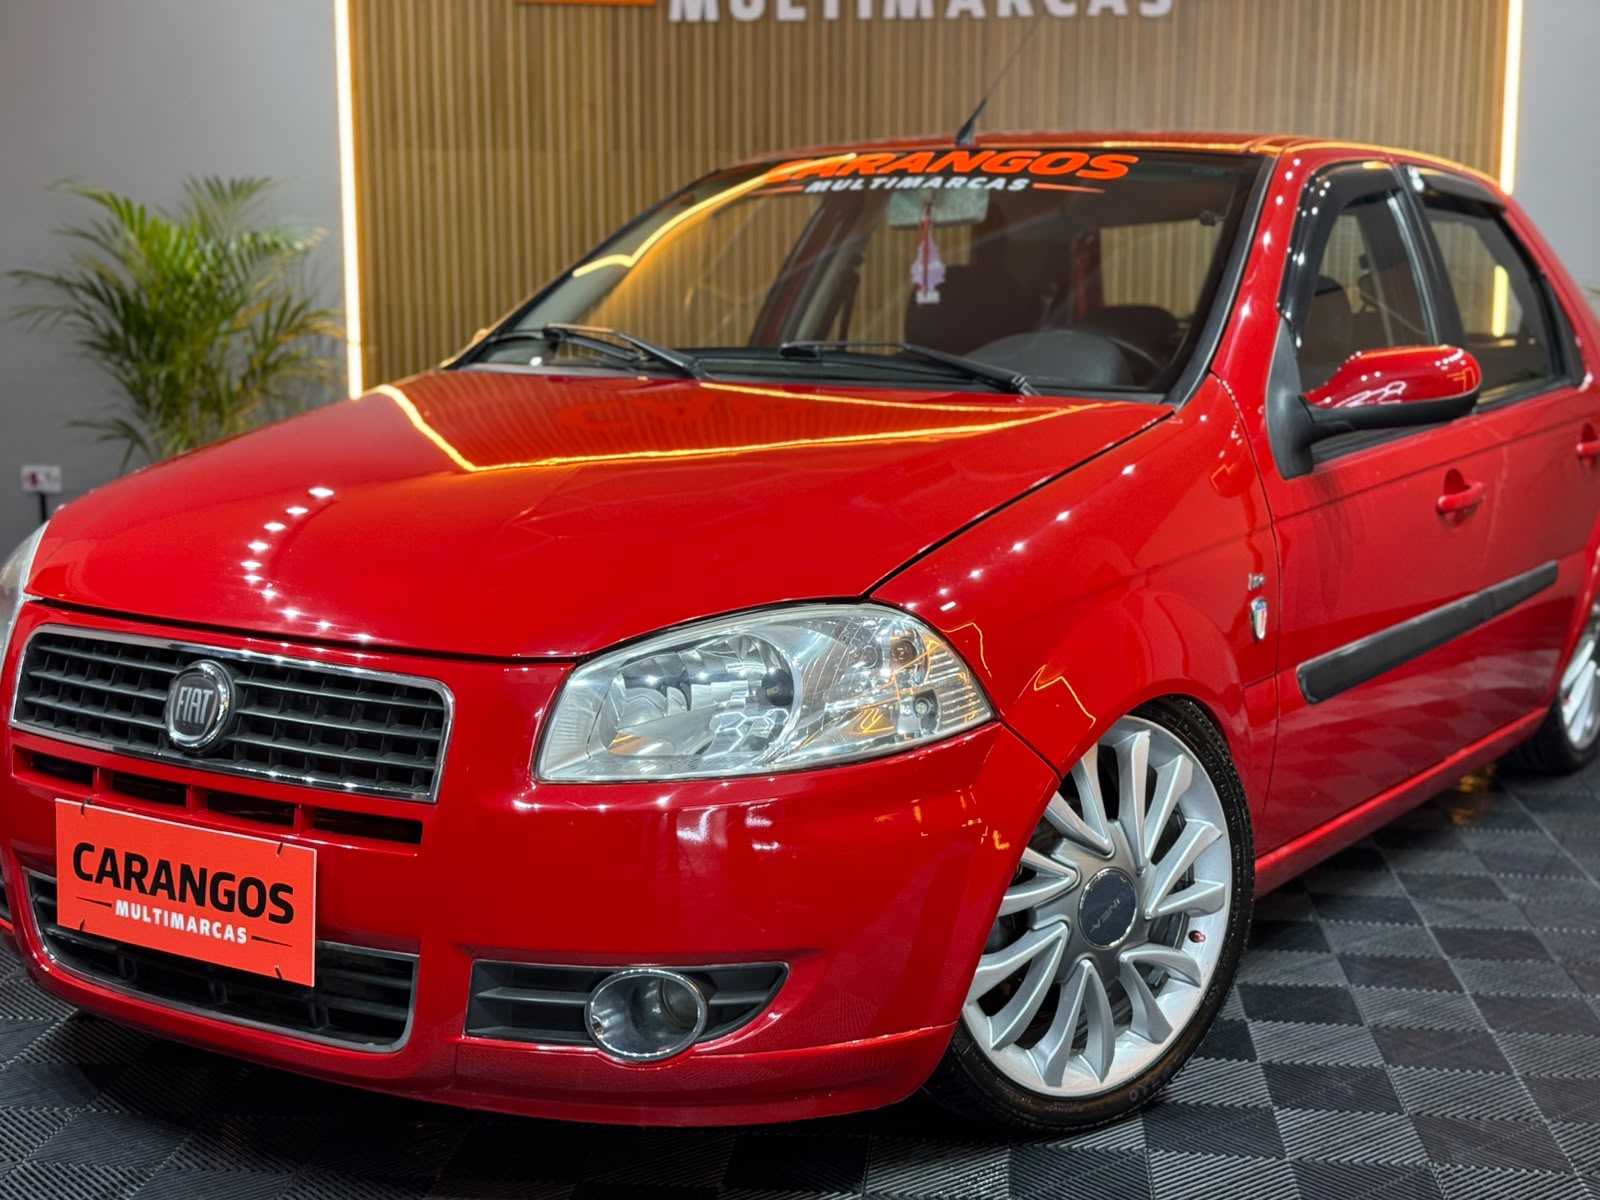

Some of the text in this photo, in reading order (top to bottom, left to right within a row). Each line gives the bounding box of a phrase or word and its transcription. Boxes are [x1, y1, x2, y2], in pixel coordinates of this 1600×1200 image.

[804, 175, 1030, 194] MULTIMARCAS
[175, 686, 215, 725] FIAT
[73, 842, 295, 925] CARANGOS
[115, 899, 248, 944] MULTIMARCAS
